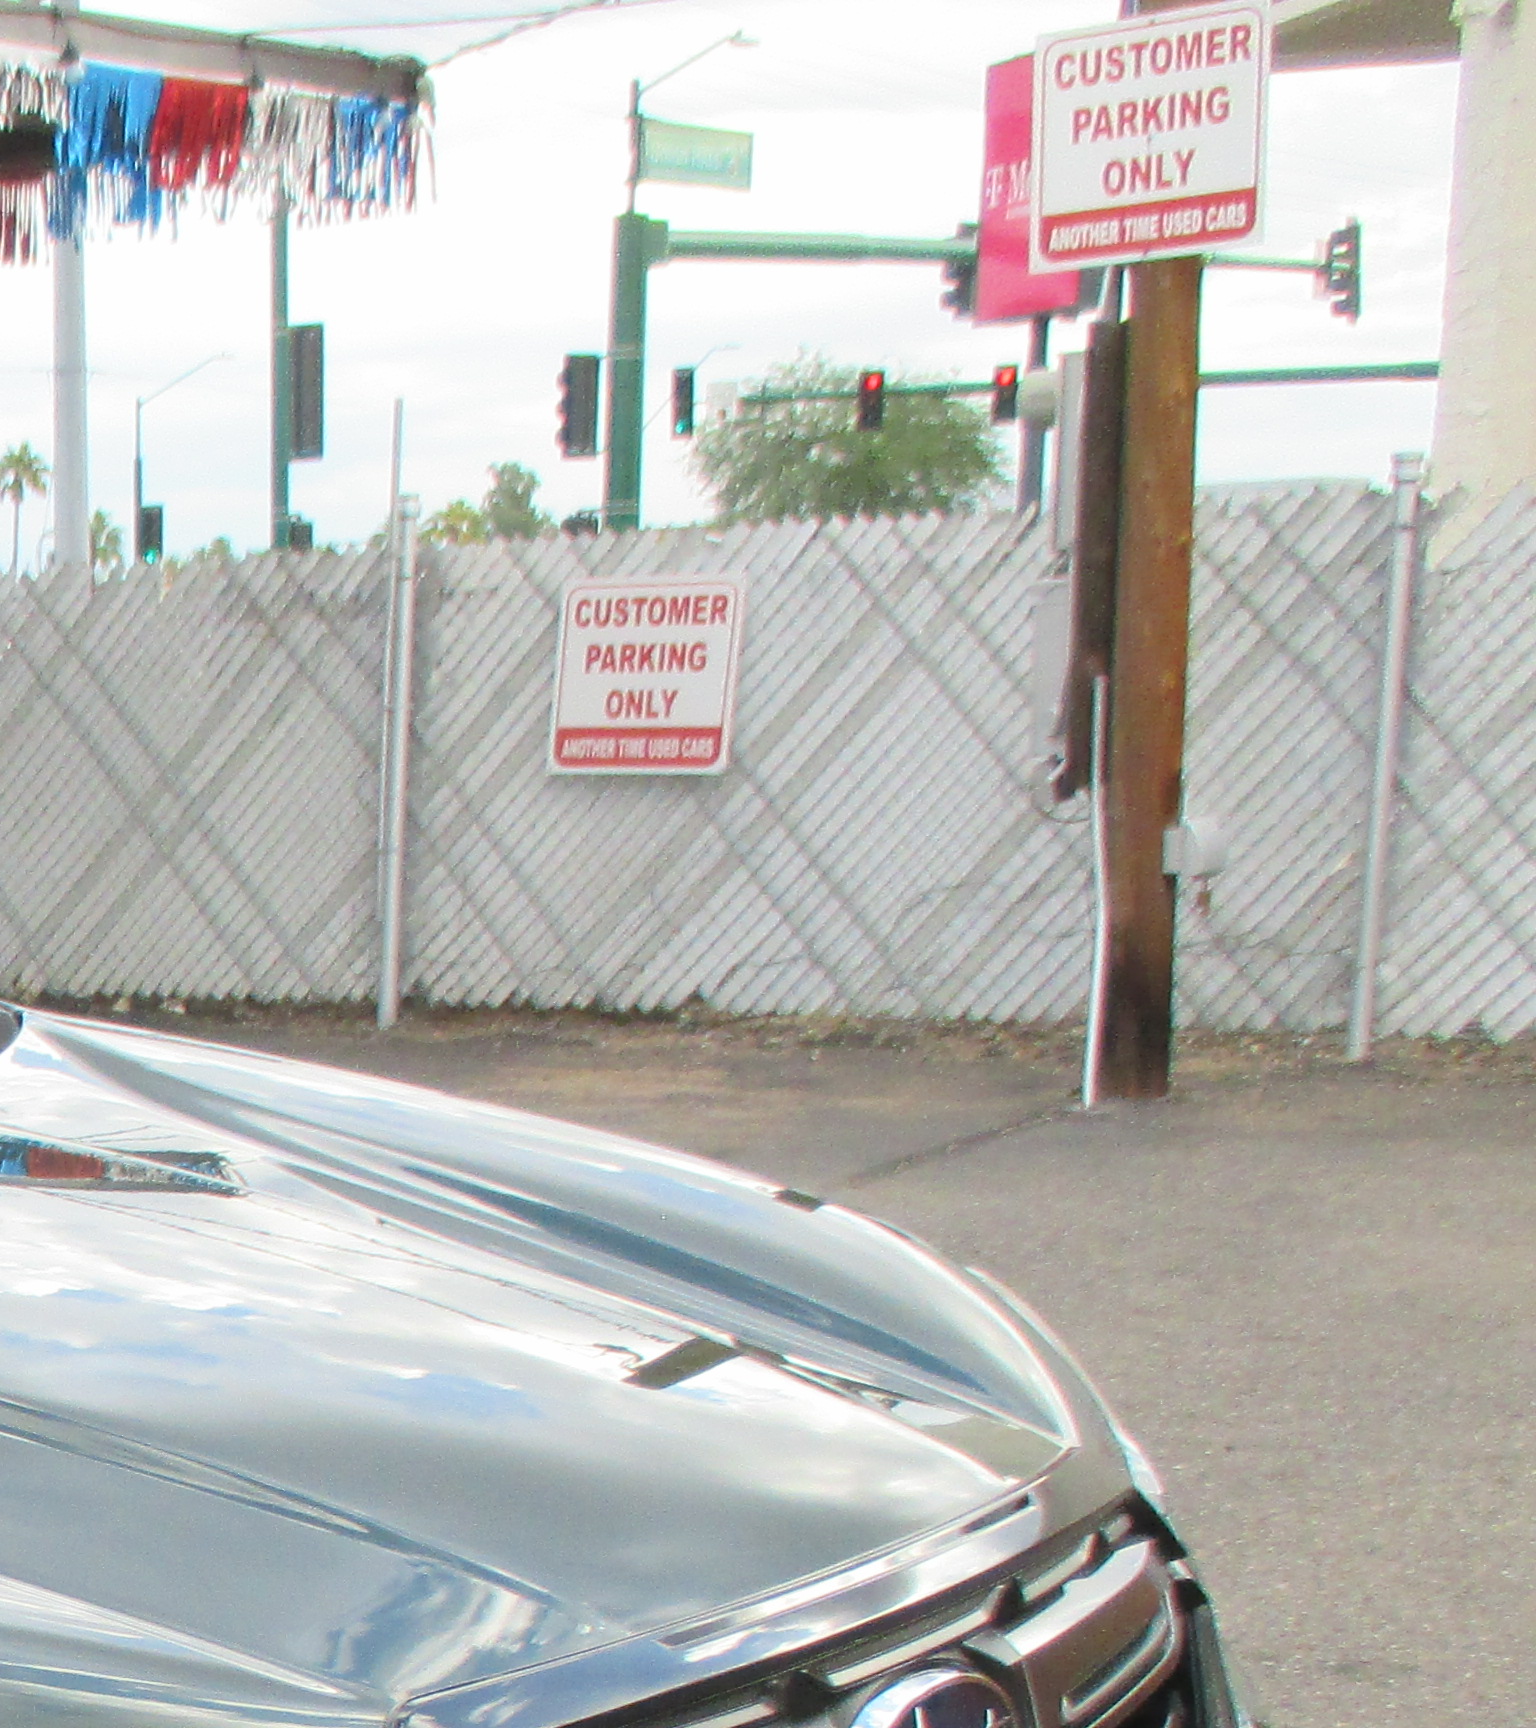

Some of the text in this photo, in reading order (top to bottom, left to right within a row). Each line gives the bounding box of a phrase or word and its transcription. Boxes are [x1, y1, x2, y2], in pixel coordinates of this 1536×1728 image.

[1056, 25, 1252, 88] CUSTOMER
[1073, 87, 1229, 143] PARKING
[1103, 150, 1195, 195] ONLY
[1049, 201, 1248, 251] ANOTHER TIME USED CARS
[575, 595, 727, 627] CUSTOMER
[586, 642, 706, 673] PARKING
[606, 690, 677, 719] ONLY
